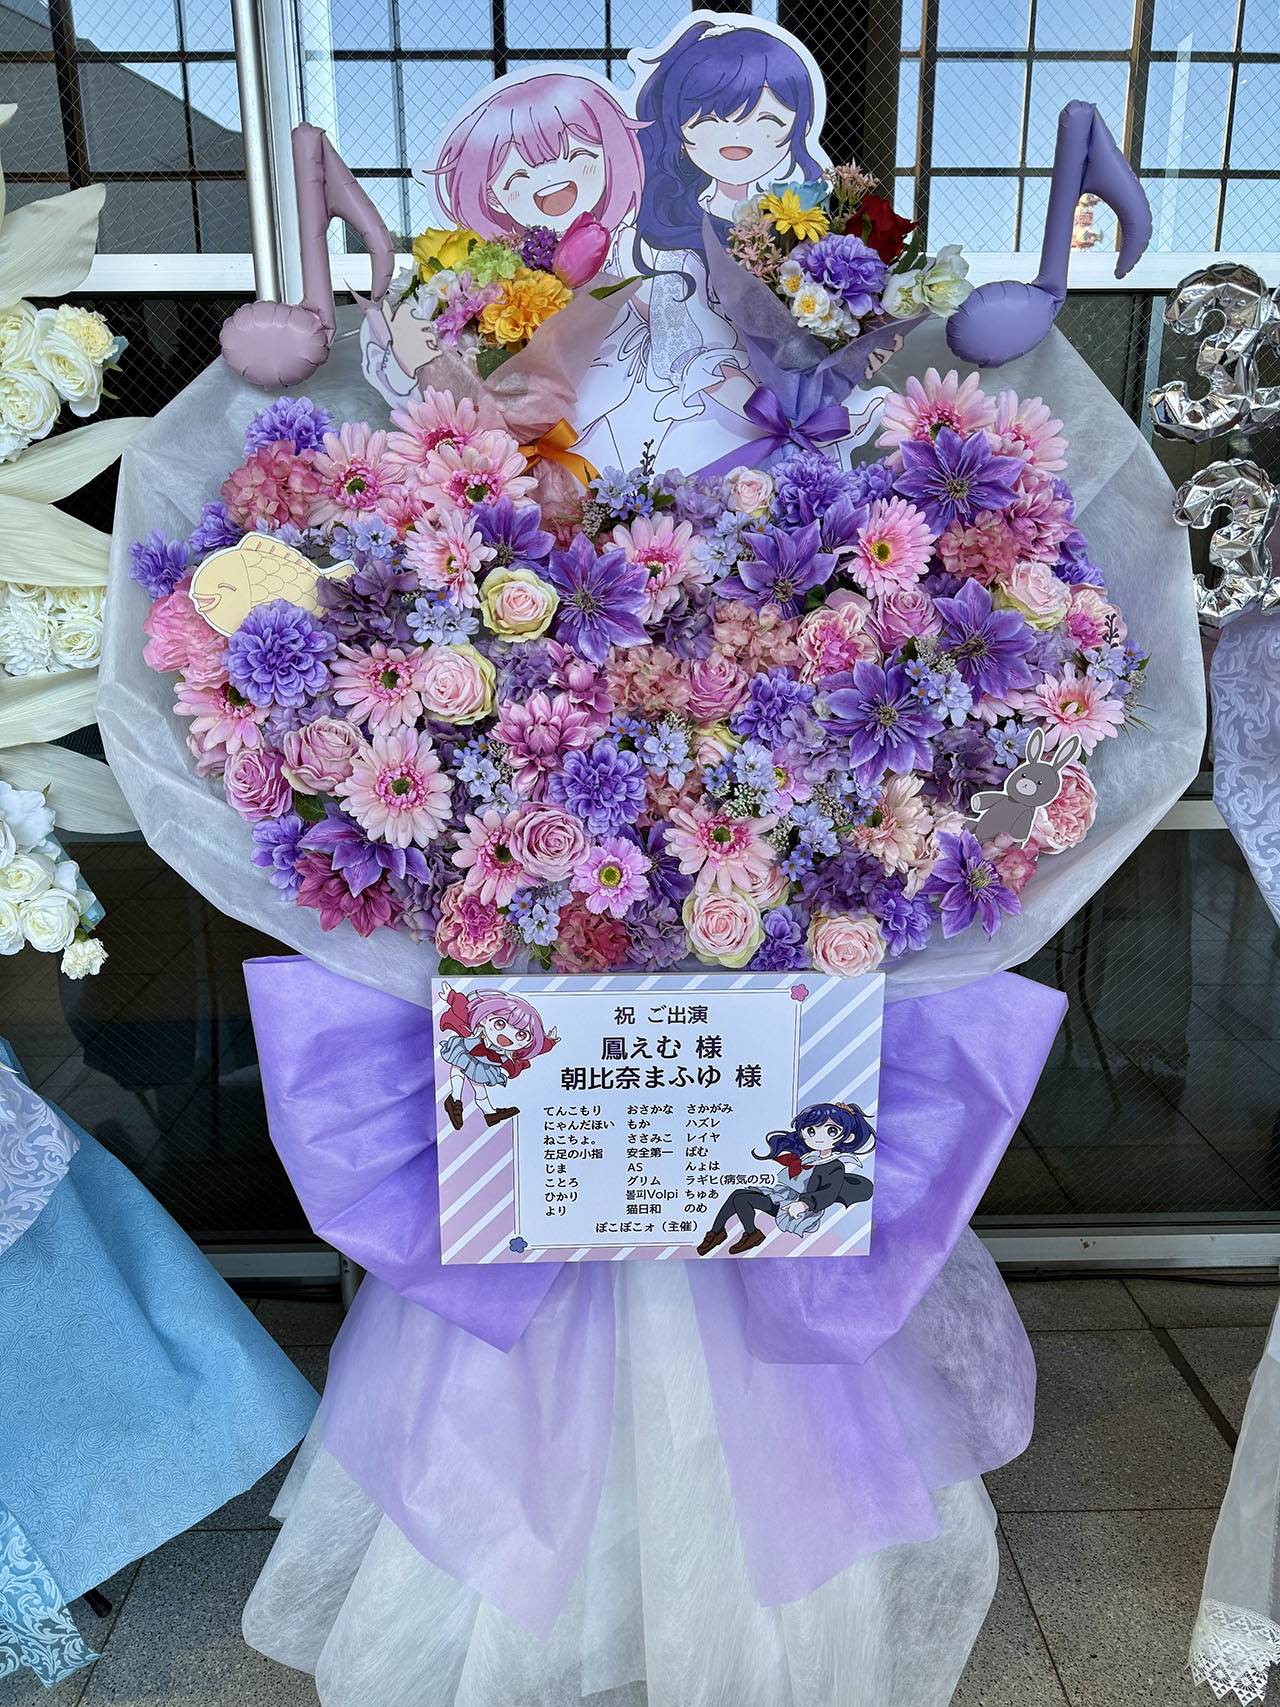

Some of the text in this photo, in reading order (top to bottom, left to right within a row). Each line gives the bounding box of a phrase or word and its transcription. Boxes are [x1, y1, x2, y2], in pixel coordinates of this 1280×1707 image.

[613, 1004, 709, 1026] 祝 ご出演
[601, 1034, 723, 1061] 鳳えむ 様
[560, 1063, 762, 1091] 朝比奈まふゆ 様
[543, 1105, 601, 1117] てんこもり
[626, 1103, 674, 1115] おさかな
[686, 1102, 734, 1115] さかがみ
[544, 1119, 615, 1132] にゃんだほい
[627, 1118, 651, 1130] もか
[685, 1116, 721, 1129] ハズレ
[543, 1134, 596, 1146] ねこちょ。
[627, 1132, 673, 1144] ささみこ
[687, 1131, 721, 1143] レイヤ
[543, 1148, 604, 1161] 左足の小指
[626, 1146, 674, 1159] 安全第一
[545, 1163, 567, 1175] じま
[627, 1162, 643, 1173] AS
[544, 1177, 579, 1188] ことろ
[627, 1175, 661, 1187] グリム
[544, 1191, 578, 1203] ひかり
[684, 1188, 719, 1200] ちゅあ
[545, 1205, 566, 1217] より
[625, 1203, 662, 1215] 猫日和
[684, 1202, 708, 1214] のめ
